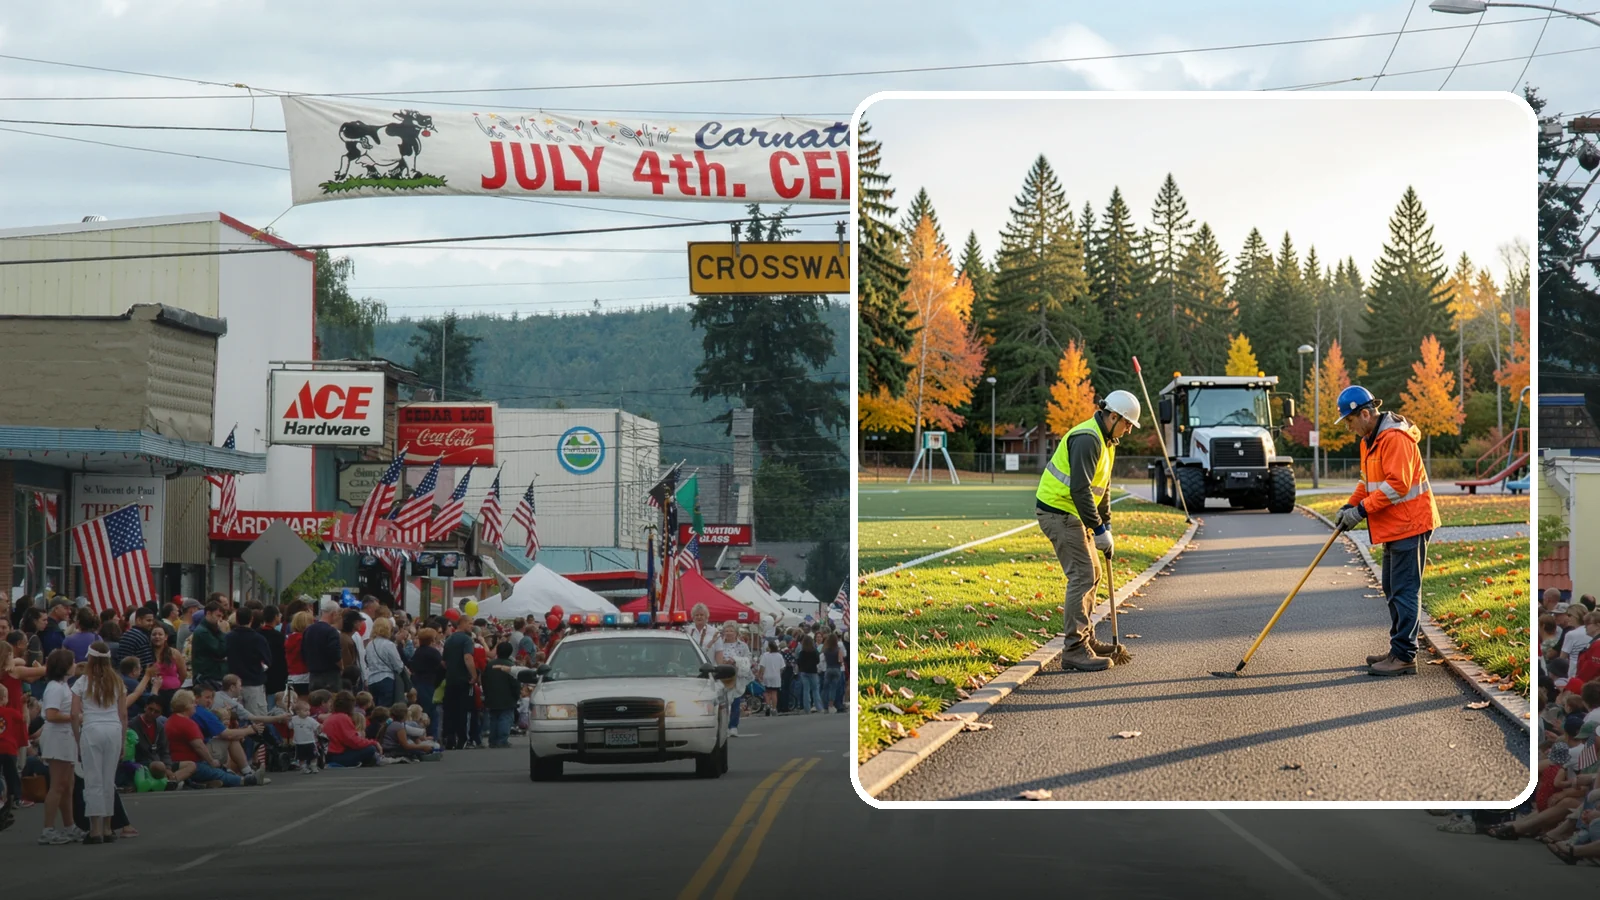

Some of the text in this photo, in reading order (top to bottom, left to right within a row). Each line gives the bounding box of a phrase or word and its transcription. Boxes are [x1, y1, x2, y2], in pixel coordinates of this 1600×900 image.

[481, 140, 605, 192] JULY
[632, 150, 746, 198] 4th.
[697, 254, 850, 280] CROSSWA
[283, 380, 373, 420] ACE
[405, 409, 485, 422] CEDAR LOG
[283, 421, 371, 436] Hardware
[416, 428, 477, 447] Coca-Cola
[354, 467, 387, 481] Simpl
[96, 485, 124, 495] Vincent
[126, 486, 136, 495] de
[137, 486, 155, 495] Paul
[688, 526, 741, 534] CRNATION
[699, 535, 730, 543] GLASS
